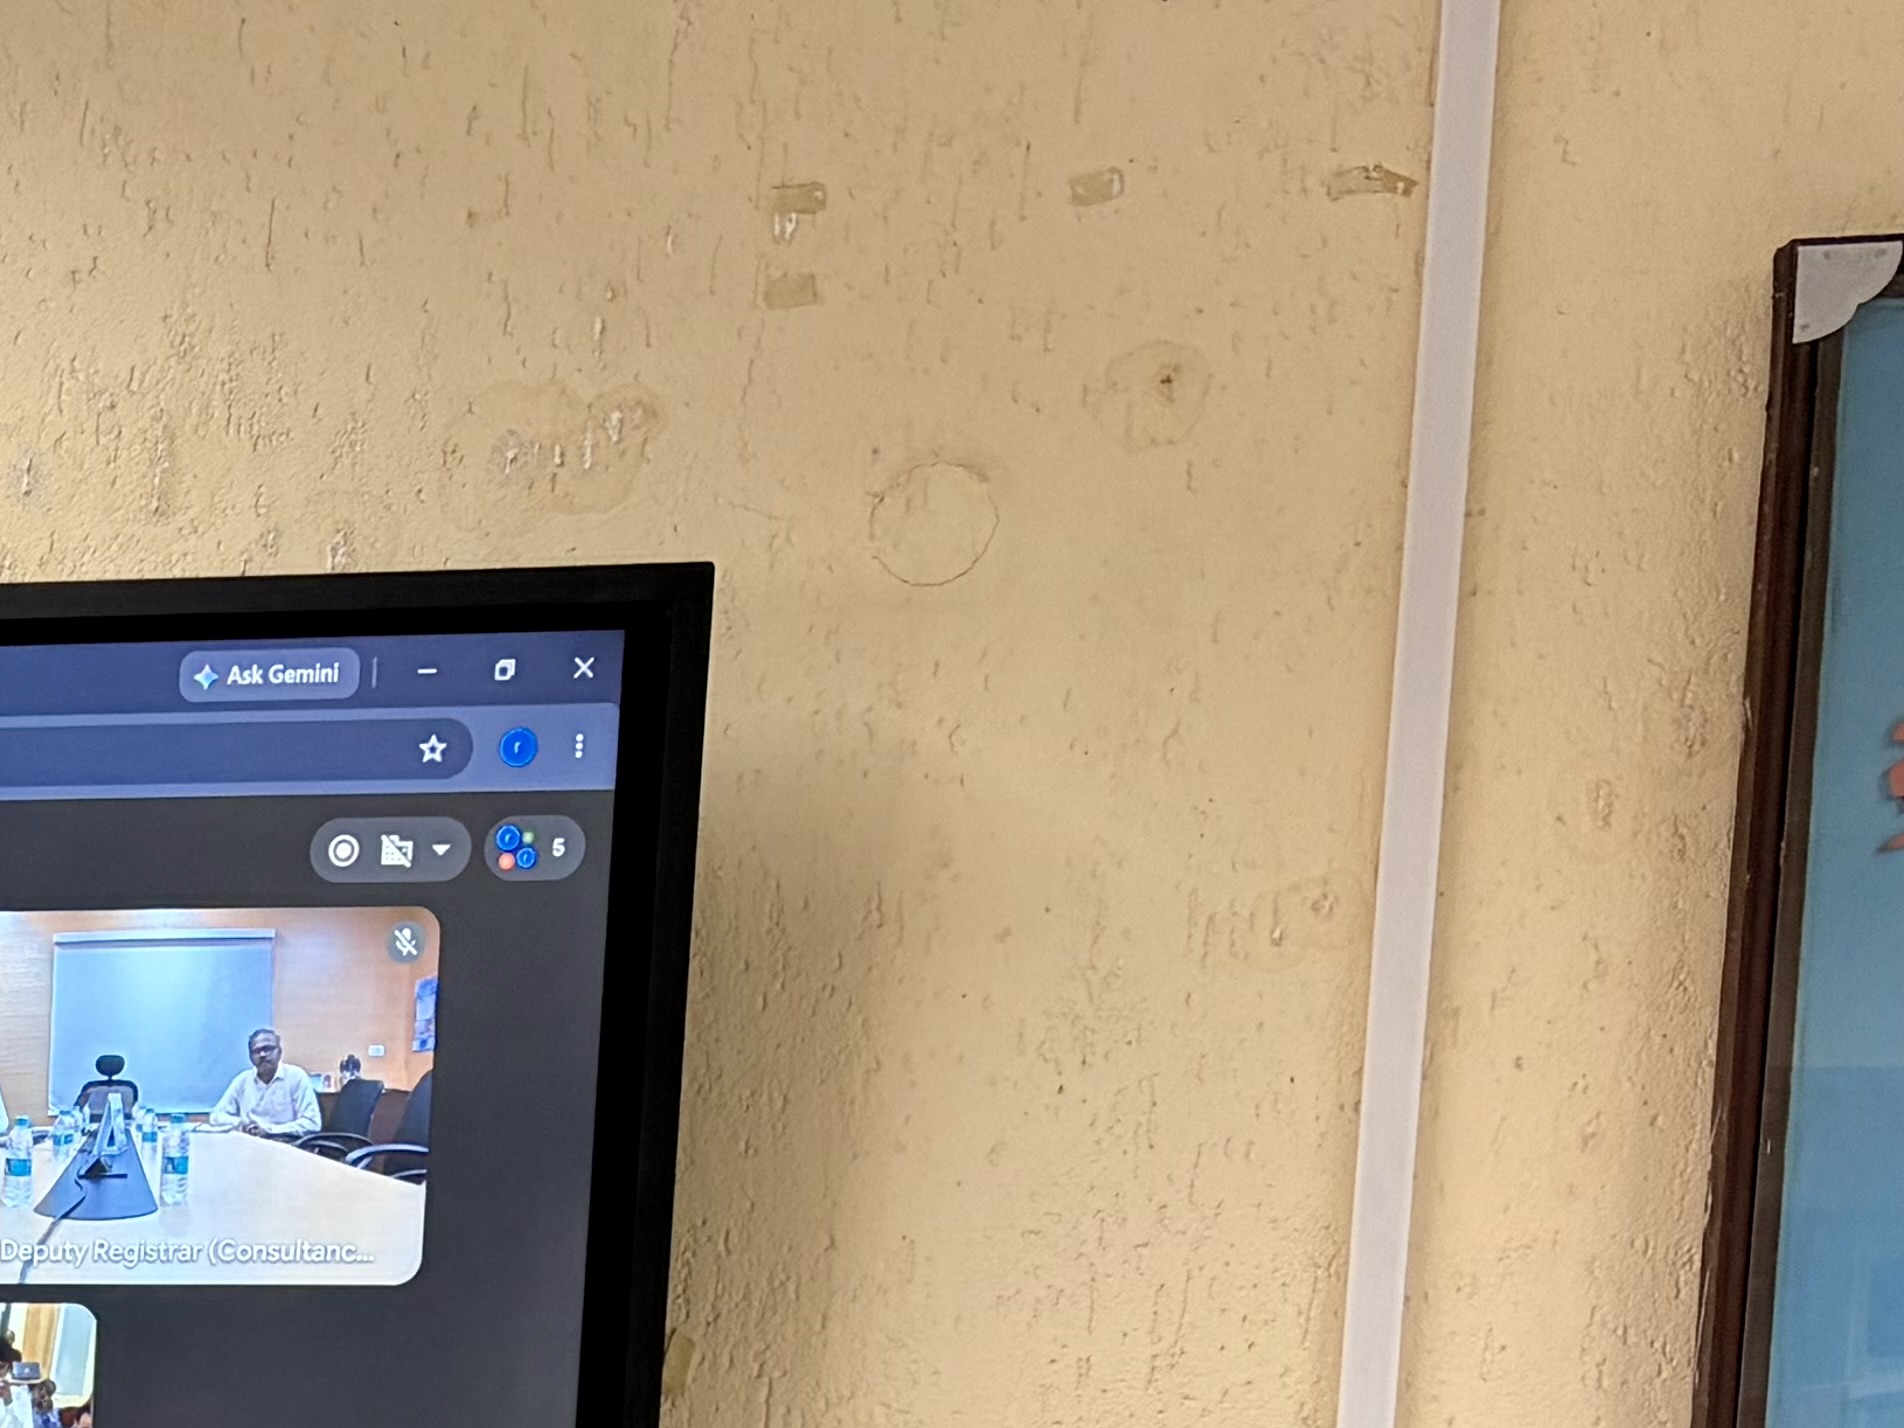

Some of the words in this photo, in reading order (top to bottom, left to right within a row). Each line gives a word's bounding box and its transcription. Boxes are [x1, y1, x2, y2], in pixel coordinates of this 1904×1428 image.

[227, 666, 263, 686] Ask
[268, 662, 340, 684] Gemini
[552, 837, 566, 857] 5
[0, 1239, 88, 1267] Deputy
[94, 1239, 204, 1268] Registrar
